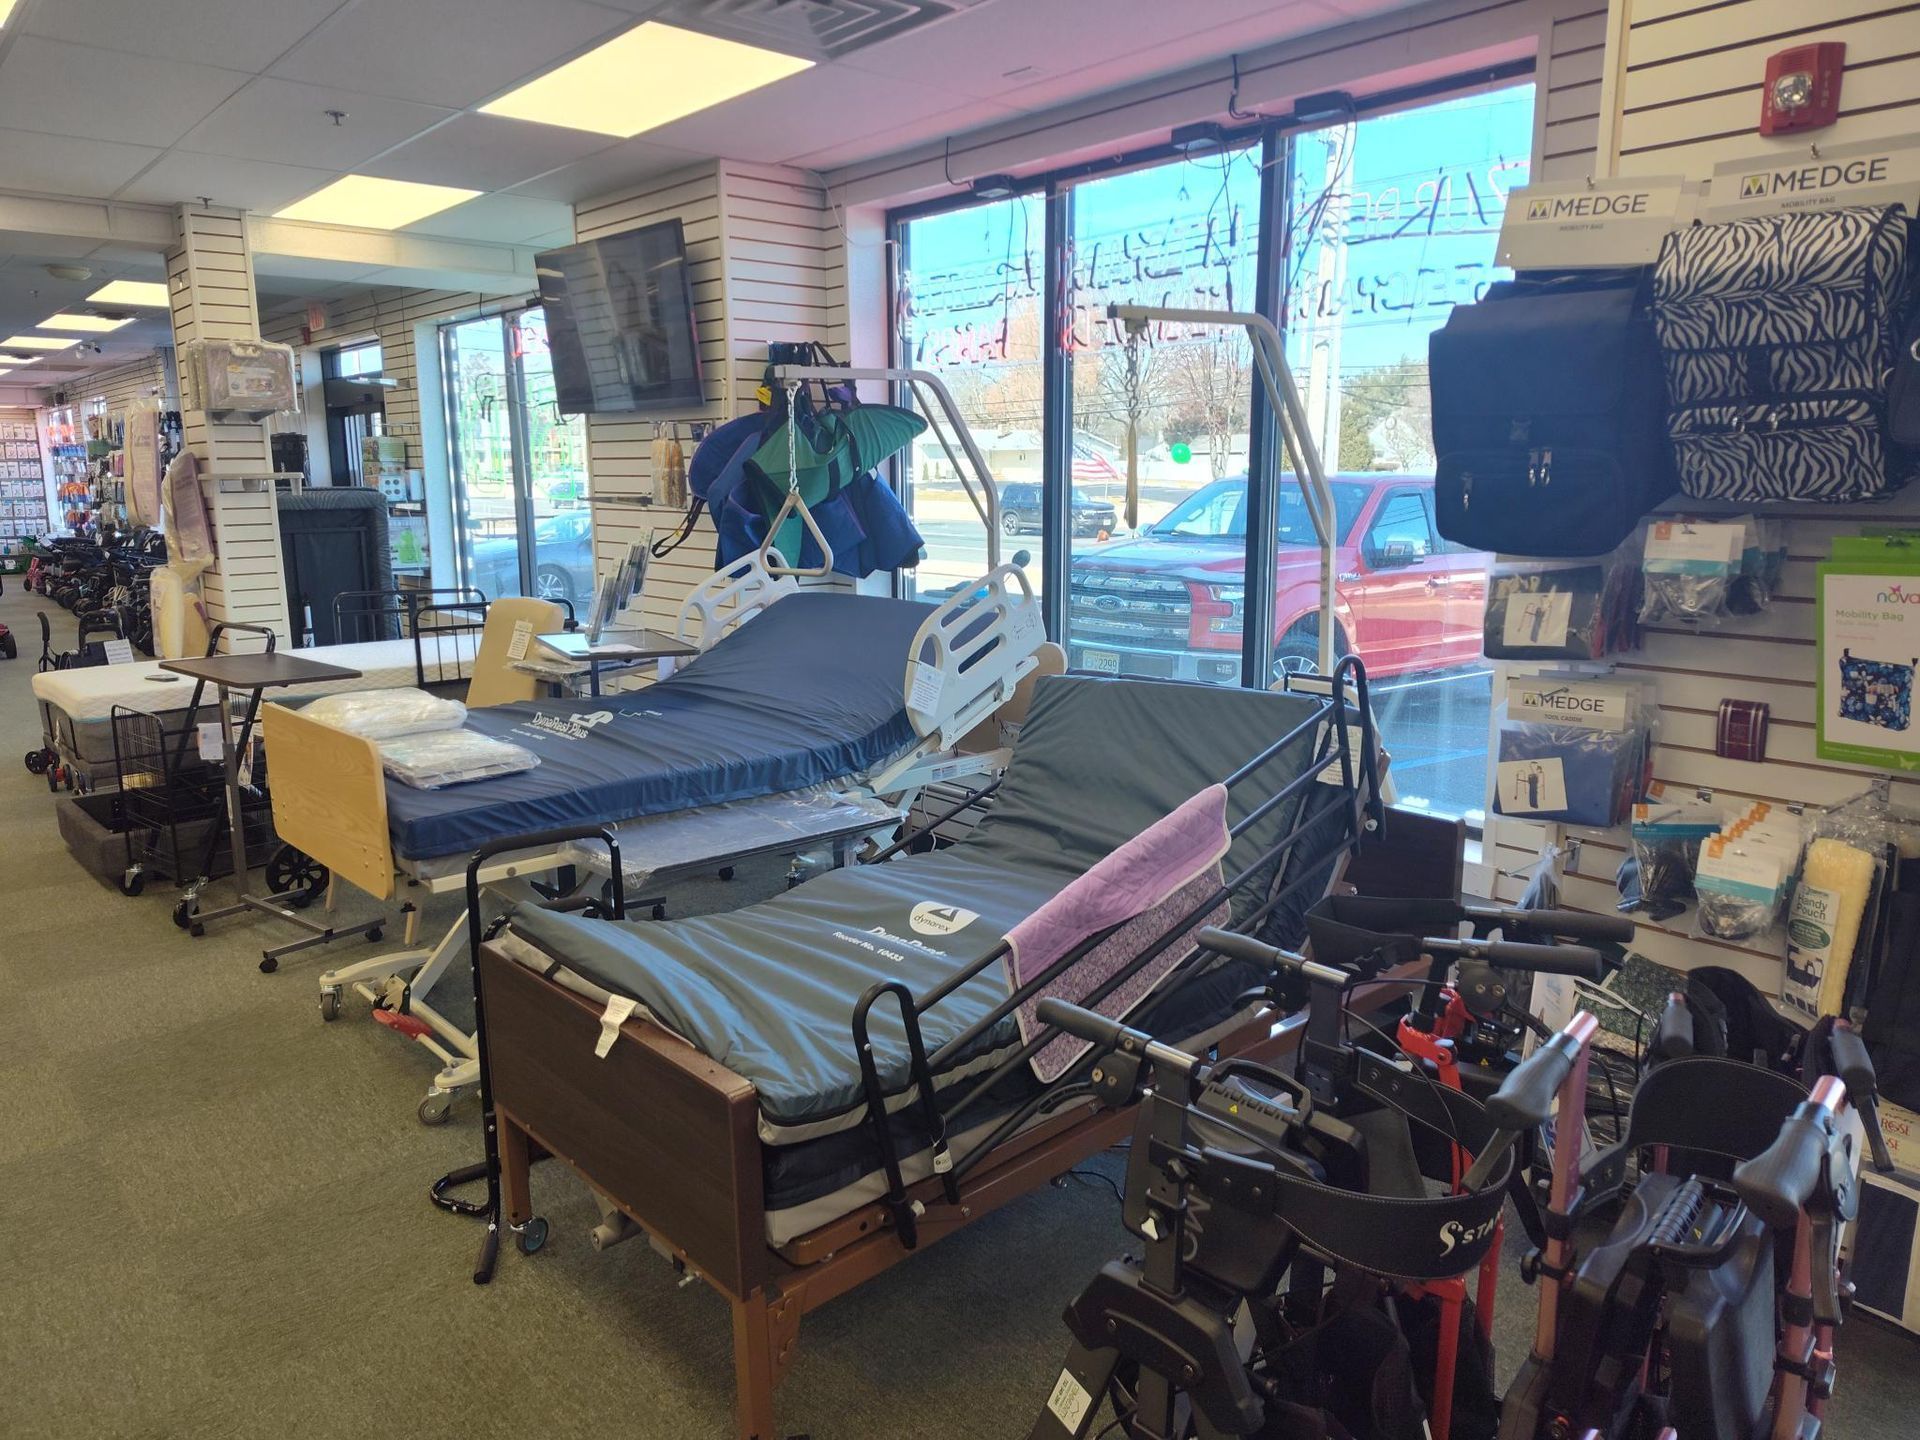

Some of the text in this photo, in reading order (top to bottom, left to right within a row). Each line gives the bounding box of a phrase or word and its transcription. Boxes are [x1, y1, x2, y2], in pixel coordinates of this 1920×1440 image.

[1772, 157, 1889, 194] MEDGE
[1553, 194, 1649, 217] MEDGE
[1836, 609, 1904, 622] Mobility Bag
[1540, 694, 1605, 712] MEDGE
[1797, 903, 1826, 920] Pouch
[913, 914, 950, 933] dynarex
